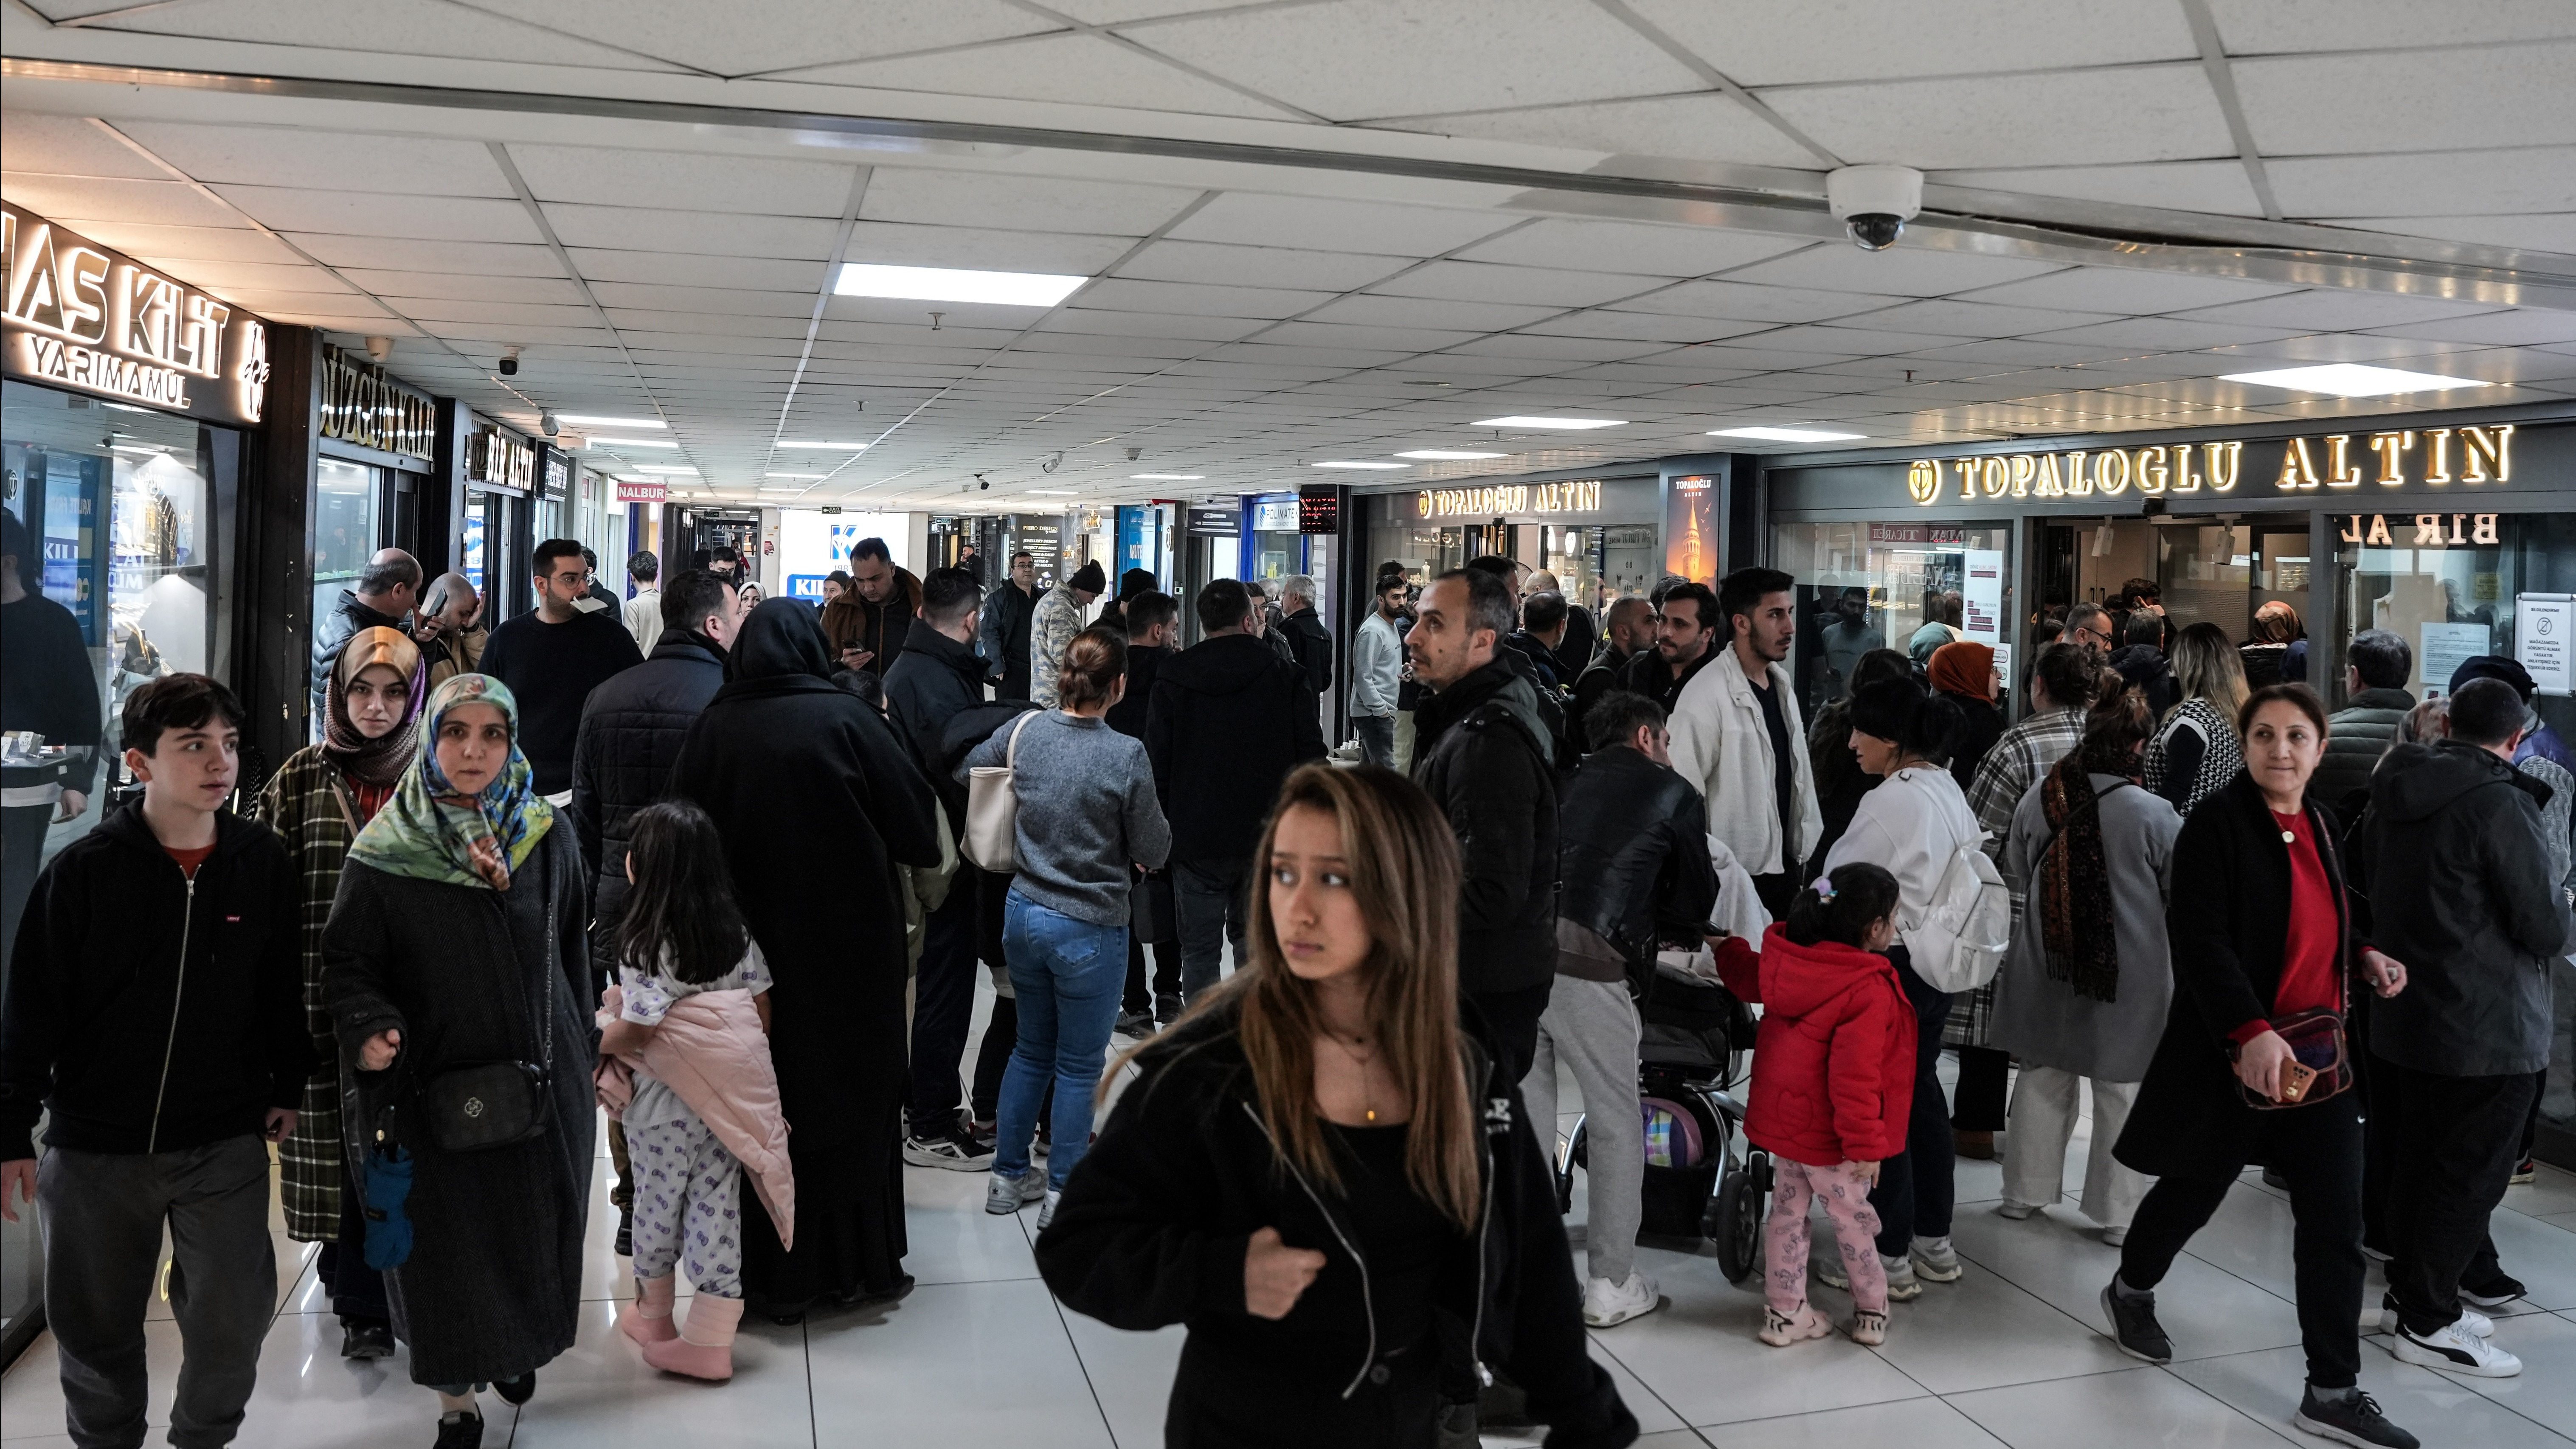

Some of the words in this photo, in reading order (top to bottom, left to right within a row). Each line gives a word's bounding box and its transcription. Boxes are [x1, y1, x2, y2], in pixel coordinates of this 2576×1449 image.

[23, 332, 191, 409] YARIMAMÜL
[487, 426, 506, 485] BİR
[508, 444, 534, 491] ALTIN
[2275, 425, 2514, 488] ALTIN
[619, 487, 664, 499] NALBUR
[1676, 479, 1711, 489] TOPALOĞLU
[1435, 485, 1528, 516] TOPALOĞLU
[1534, 481, 1601, 512] ALTIN
[1266, 505, 1299, 520] POLİMATEK
[2031, 613, 2037, 625] 4
